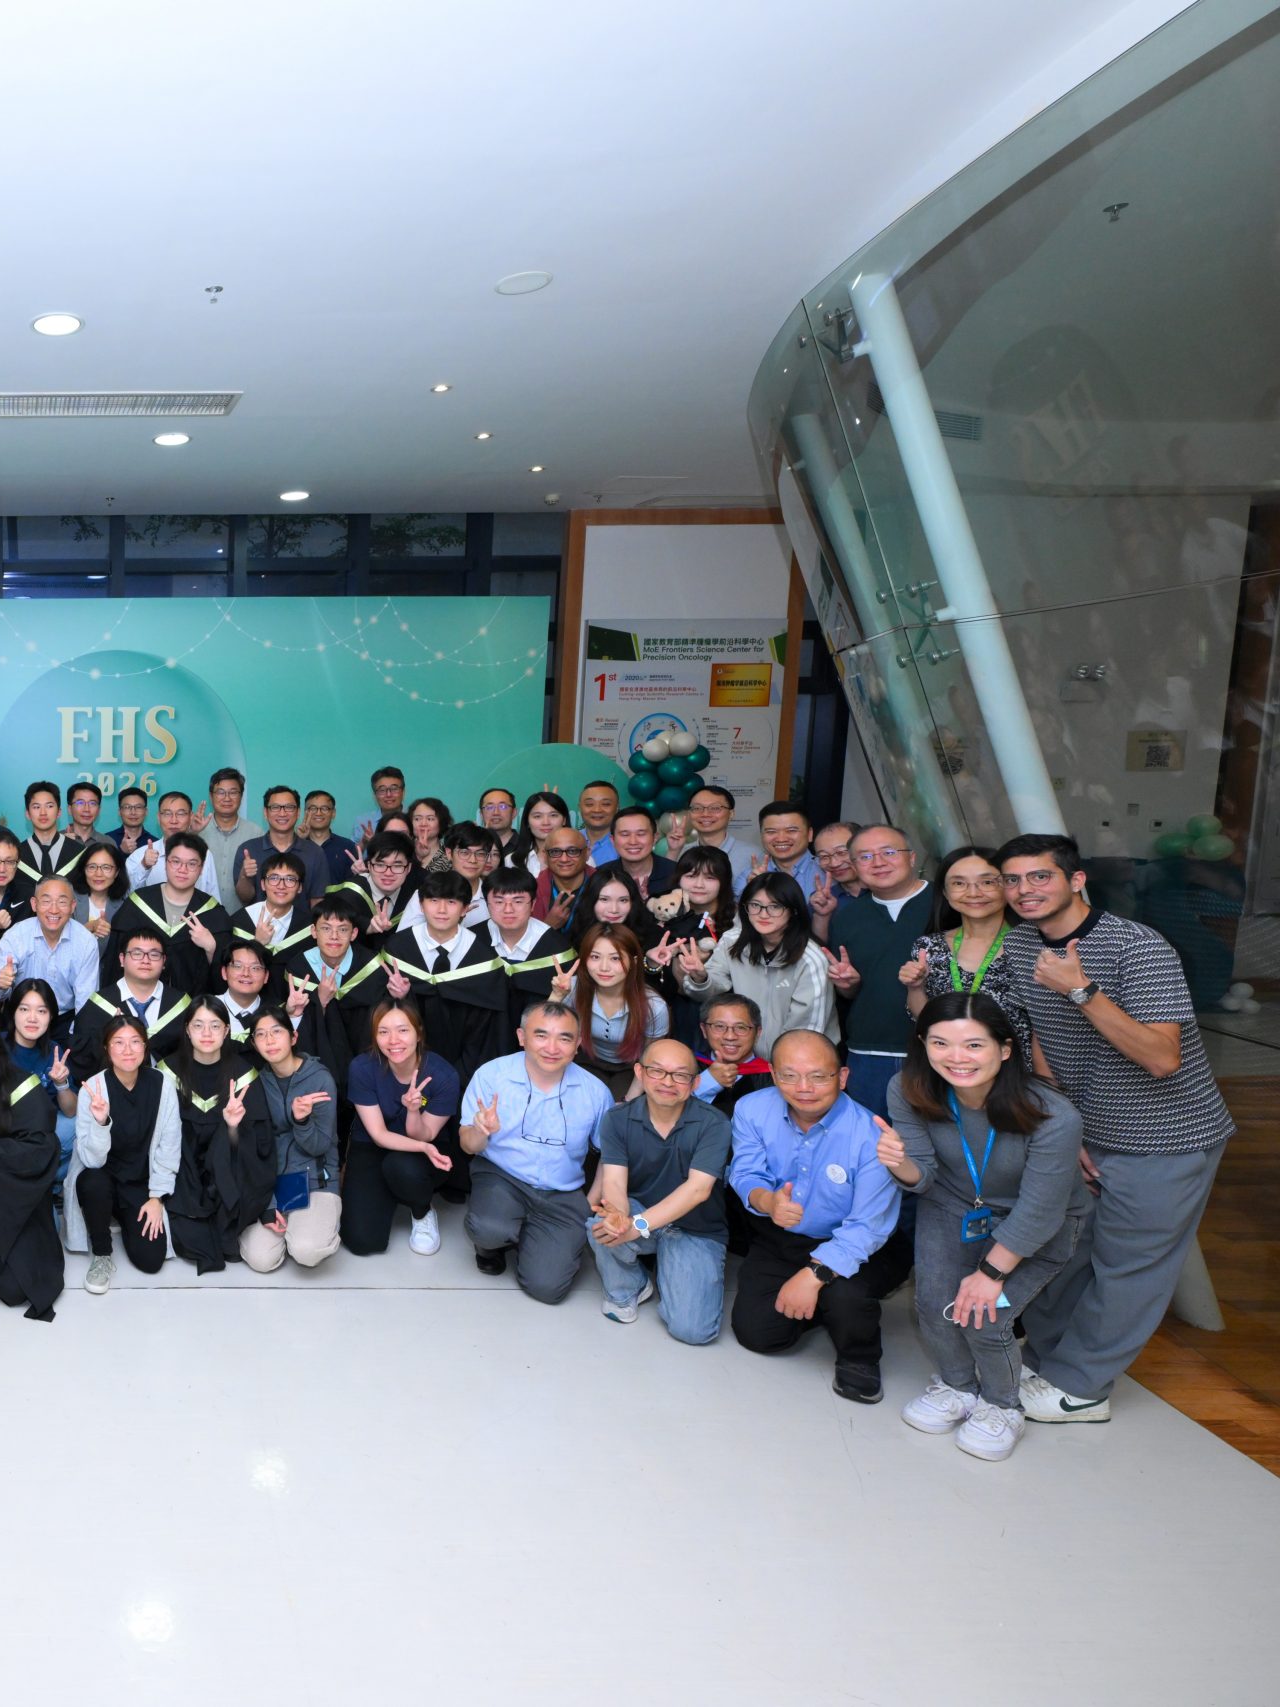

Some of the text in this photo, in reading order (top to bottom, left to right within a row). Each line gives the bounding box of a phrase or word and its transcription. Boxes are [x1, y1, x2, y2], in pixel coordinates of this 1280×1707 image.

[678, 654, 712, 662] Oncology
[56, 705, 177, 764] FHS
[733, 727, 741, 739] 7
